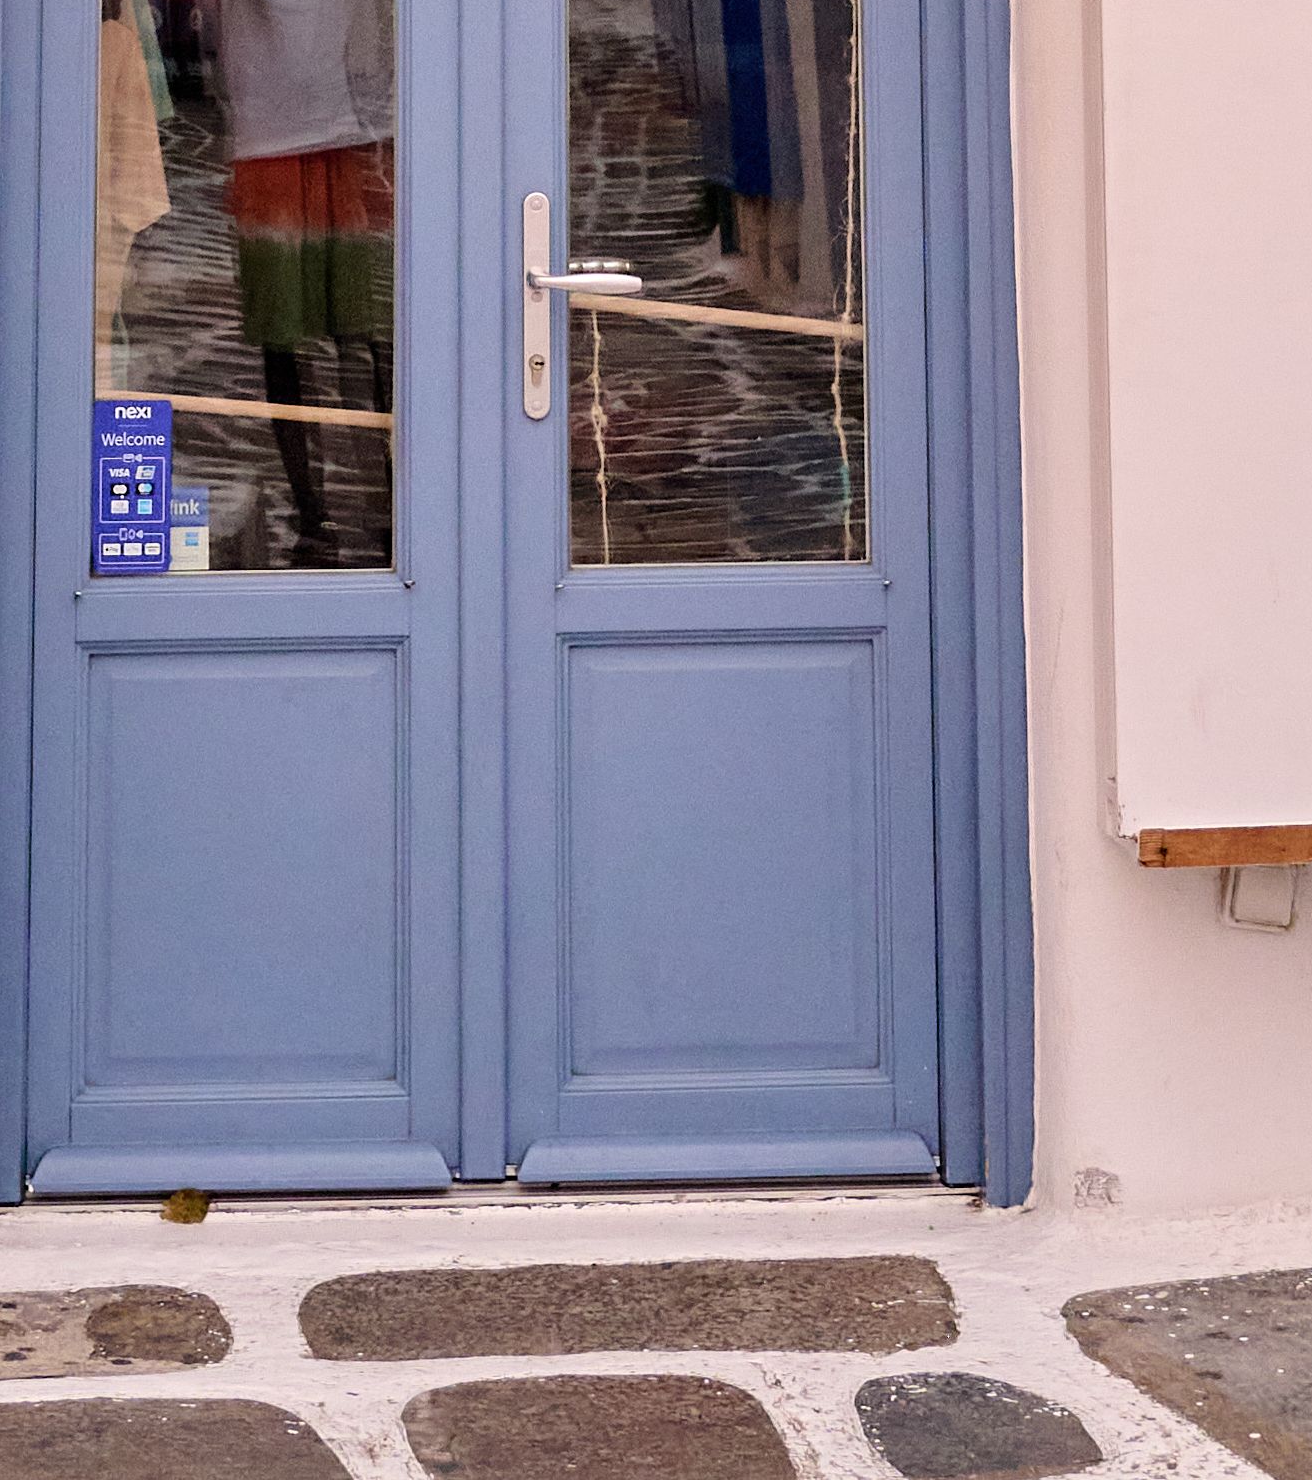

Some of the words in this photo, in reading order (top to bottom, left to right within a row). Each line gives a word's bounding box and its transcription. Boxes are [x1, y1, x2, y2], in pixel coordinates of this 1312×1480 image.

[114, 406, 152, 419] nexi
[101, 432, 166, 446] Welcome
[108, 468, 130, 478] VISA
